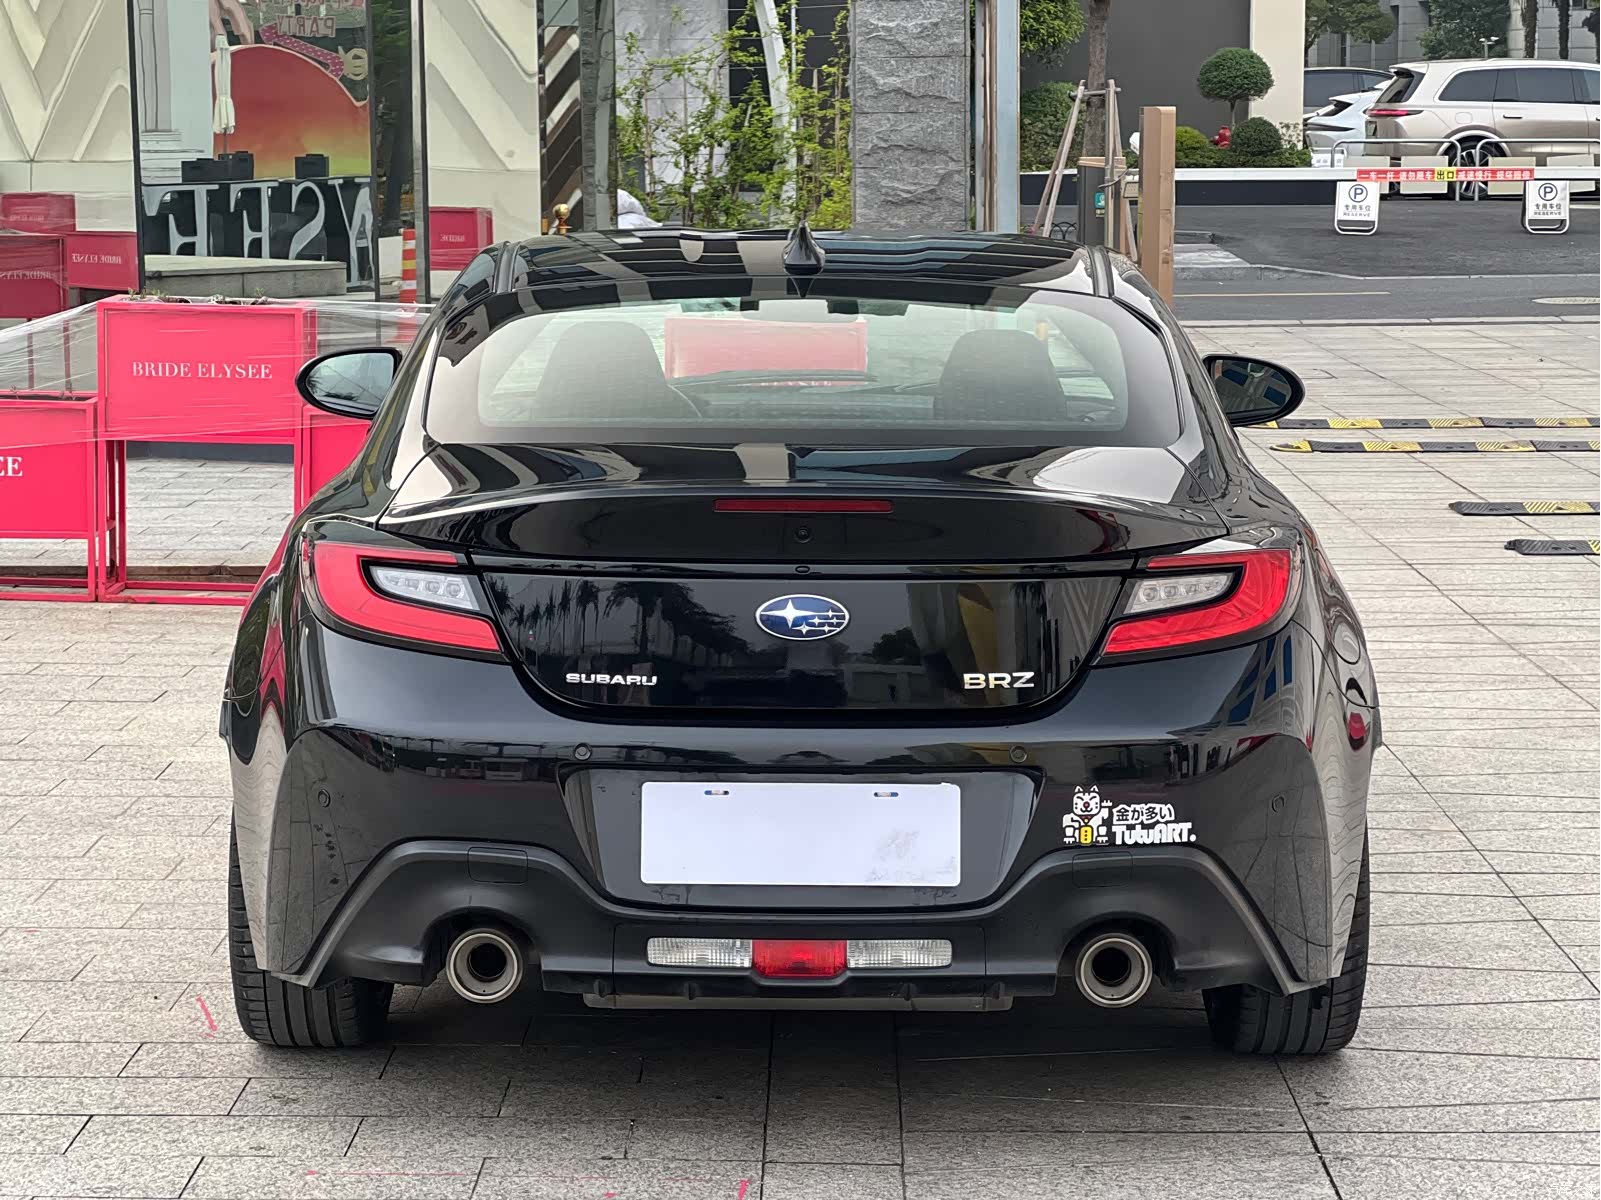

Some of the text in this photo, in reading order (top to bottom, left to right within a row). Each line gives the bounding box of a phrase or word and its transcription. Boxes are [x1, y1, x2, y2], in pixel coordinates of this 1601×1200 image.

[1436, 170, 1456, 180] 出口
[1354, 187, 1364, 200] P
[1543, 185, 1553, 198] P
[132, 361, 273, 380] BRIDE ELYSEE
[565, 673, 658, 686] SUBARU
[963, 671, 1035, 690] BRZ
[1114, 805, 1174, 823] 金が多い
